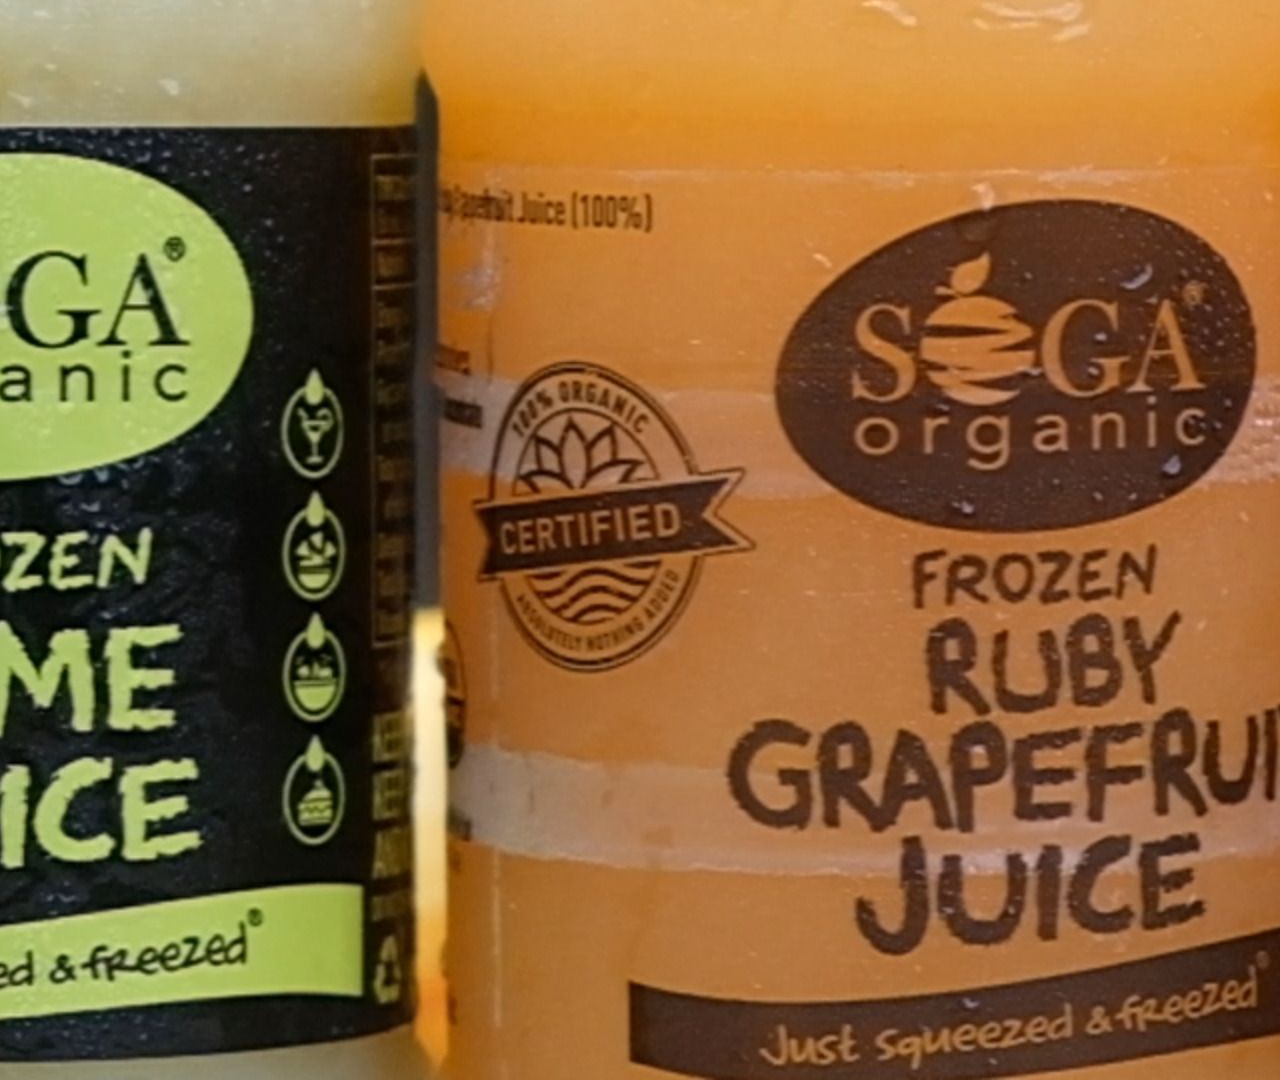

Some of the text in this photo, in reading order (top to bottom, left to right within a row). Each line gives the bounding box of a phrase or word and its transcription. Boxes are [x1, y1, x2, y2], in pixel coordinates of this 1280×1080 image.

[517, 191, 566, 226] Juice
[572, 191, 653, 233] (100%)
[512, 390, 554, 437] 100%
[558, 379, 651, 435] ORGANIC
[853, 400, 1205, 469] organic
[500, 503, 680, 554] CERTIFIED
[643, 569, 680, 618] ADDED
[912, 545, 1158, 609] FROZEN
[925, 611, 1181, 716] RUBY
[854, 831, 1205, 957] JUICE
[49, 954, 77, 984] &
[759, 1024, 861, 1068] Just
[876, 1002, 1074, 1071] squeezed
[1085, 1005, 1112, 1035] &
